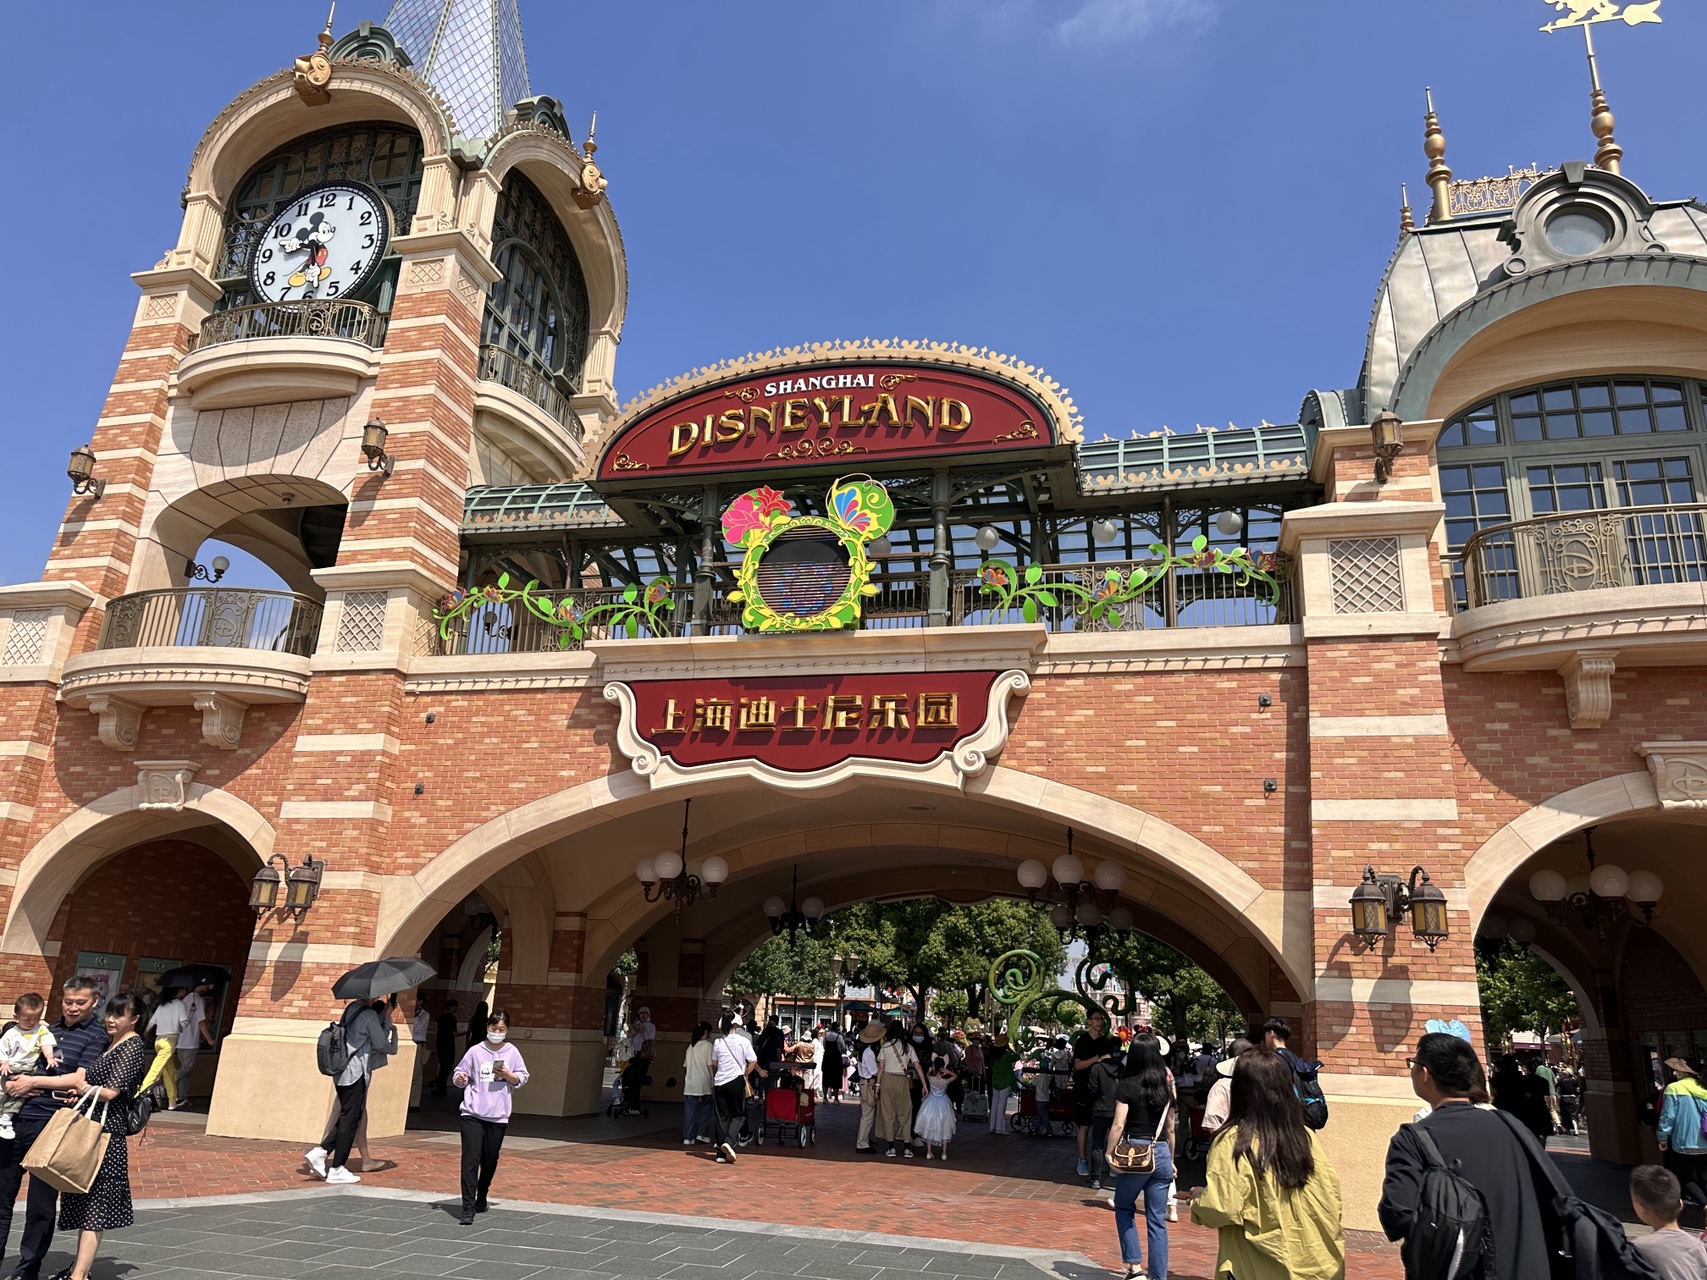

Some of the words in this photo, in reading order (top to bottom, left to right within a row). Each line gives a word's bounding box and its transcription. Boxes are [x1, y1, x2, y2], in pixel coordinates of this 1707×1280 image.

[318, 193, 337, 209] 12
[347, 196, 355, 211] 1
[295, 202, 310, 218] 11
[359, 211, 372, 226] 2
[272, 223, 292, 239] 10
[361, 234, 375, 249] 3
[261, 249, 273, 264] 9
[349, 260, 362, 275] 4
[263, 271, 276, 286] 8
[280, 287, 292, 301] 7
[326, 281, 340, 297] 5
[764, 374, 875, 397] SHANGHAI
[668, 393, 972, 457] DISNEYLAND
[650, 692, 959, 733] 上海迪士尼乐园
